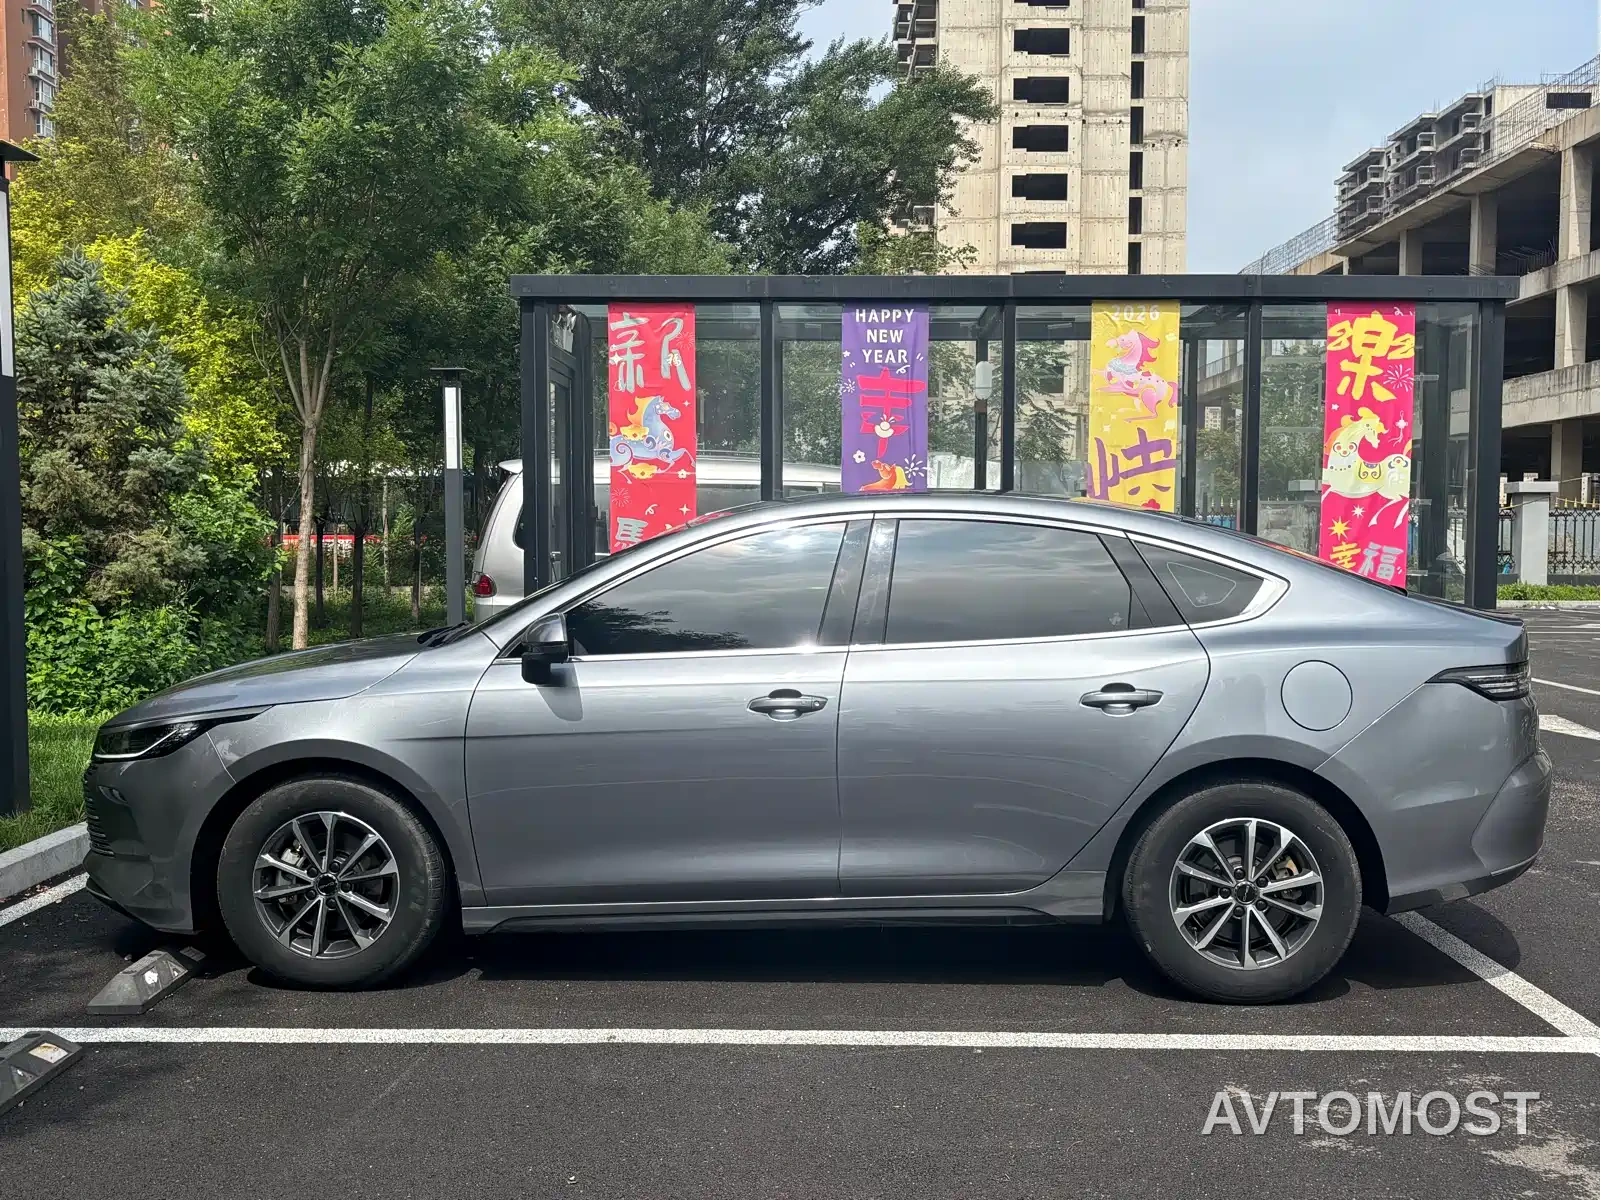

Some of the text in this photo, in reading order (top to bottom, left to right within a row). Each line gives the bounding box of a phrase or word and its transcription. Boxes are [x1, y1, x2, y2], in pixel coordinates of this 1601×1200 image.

[855, 308, 915, 323] HAPPY
[1111, 305, 1160, 321] 2026
[866, 329, 904, 343] NEW
[862, 349, 908, 364] YEAR
[1330, 541, 1404, 581] 幸福
